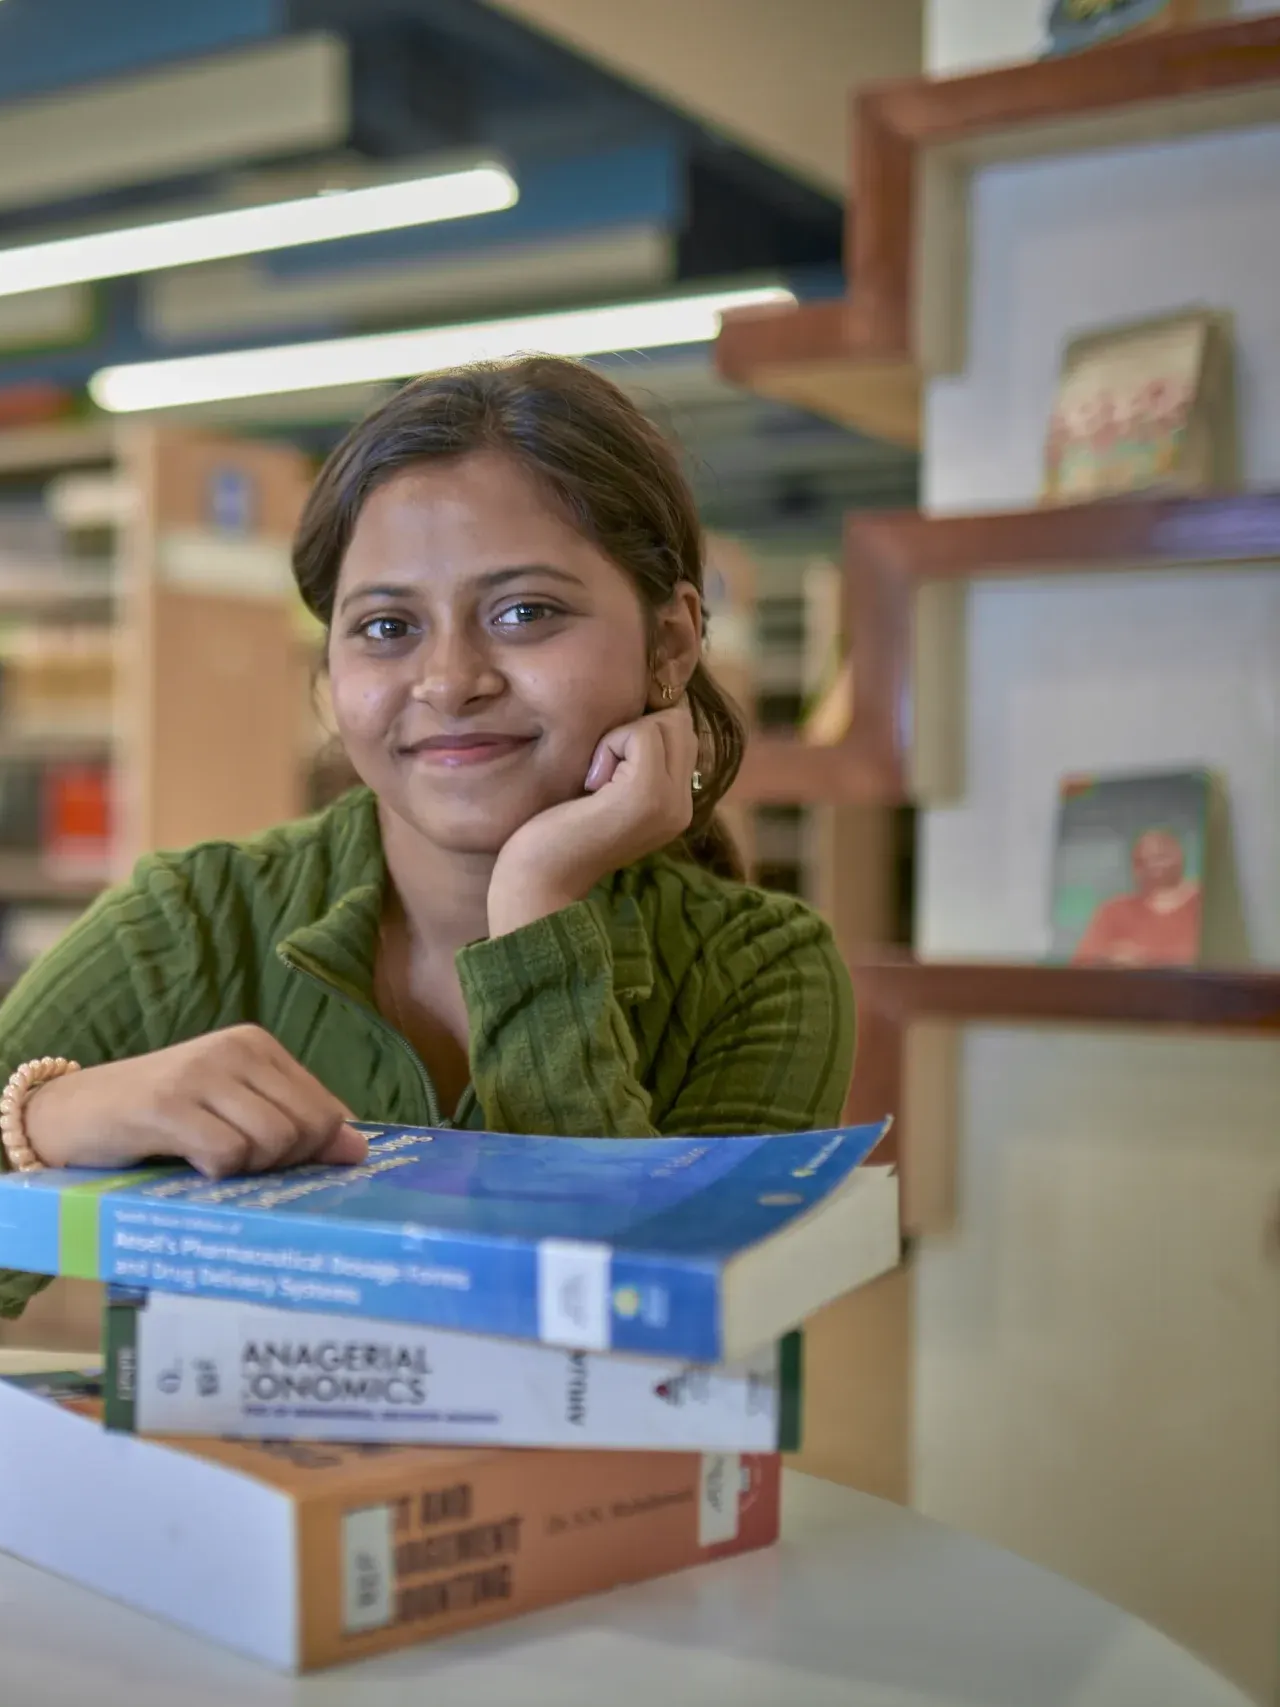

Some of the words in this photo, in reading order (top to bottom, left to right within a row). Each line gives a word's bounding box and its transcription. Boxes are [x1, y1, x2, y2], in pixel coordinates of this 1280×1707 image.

[179, 1236, 323, 1273] Pharmaceutical
[116, 1259, 149, 1279] and
[152, 1260, 196, 1290] Drug
[199, 1266, 276, 1297] Delivery
[278, 1275, 361, 1305] Systems
[240, 1373, 427, 1406] ONOMICS
